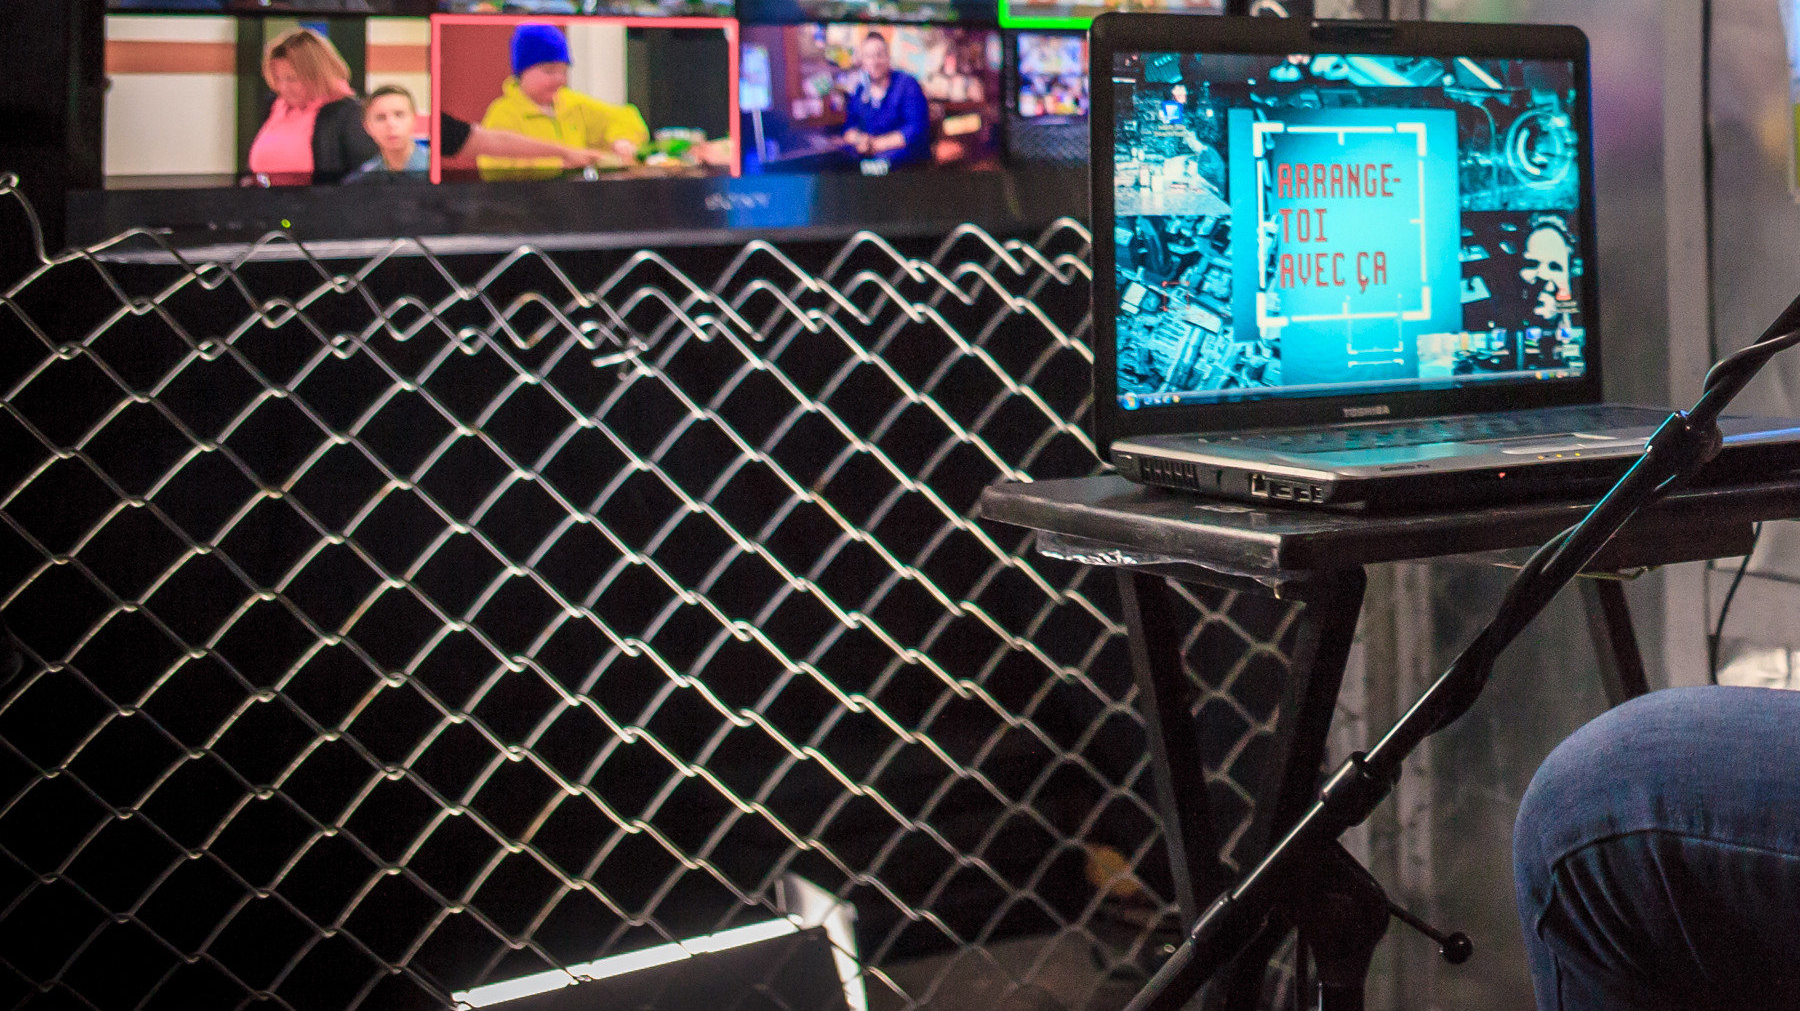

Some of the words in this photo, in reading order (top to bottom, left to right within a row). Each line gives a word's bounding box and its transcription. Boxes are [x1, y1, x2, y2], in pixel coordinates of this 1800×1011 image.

[1277, 163, 1401, 198] ARRANGE-
[1279, 208, 1328, 243] TOI
[1280, 252, 1345, 288] AVEC
[1357, 251, 1387, 294] ÇA
